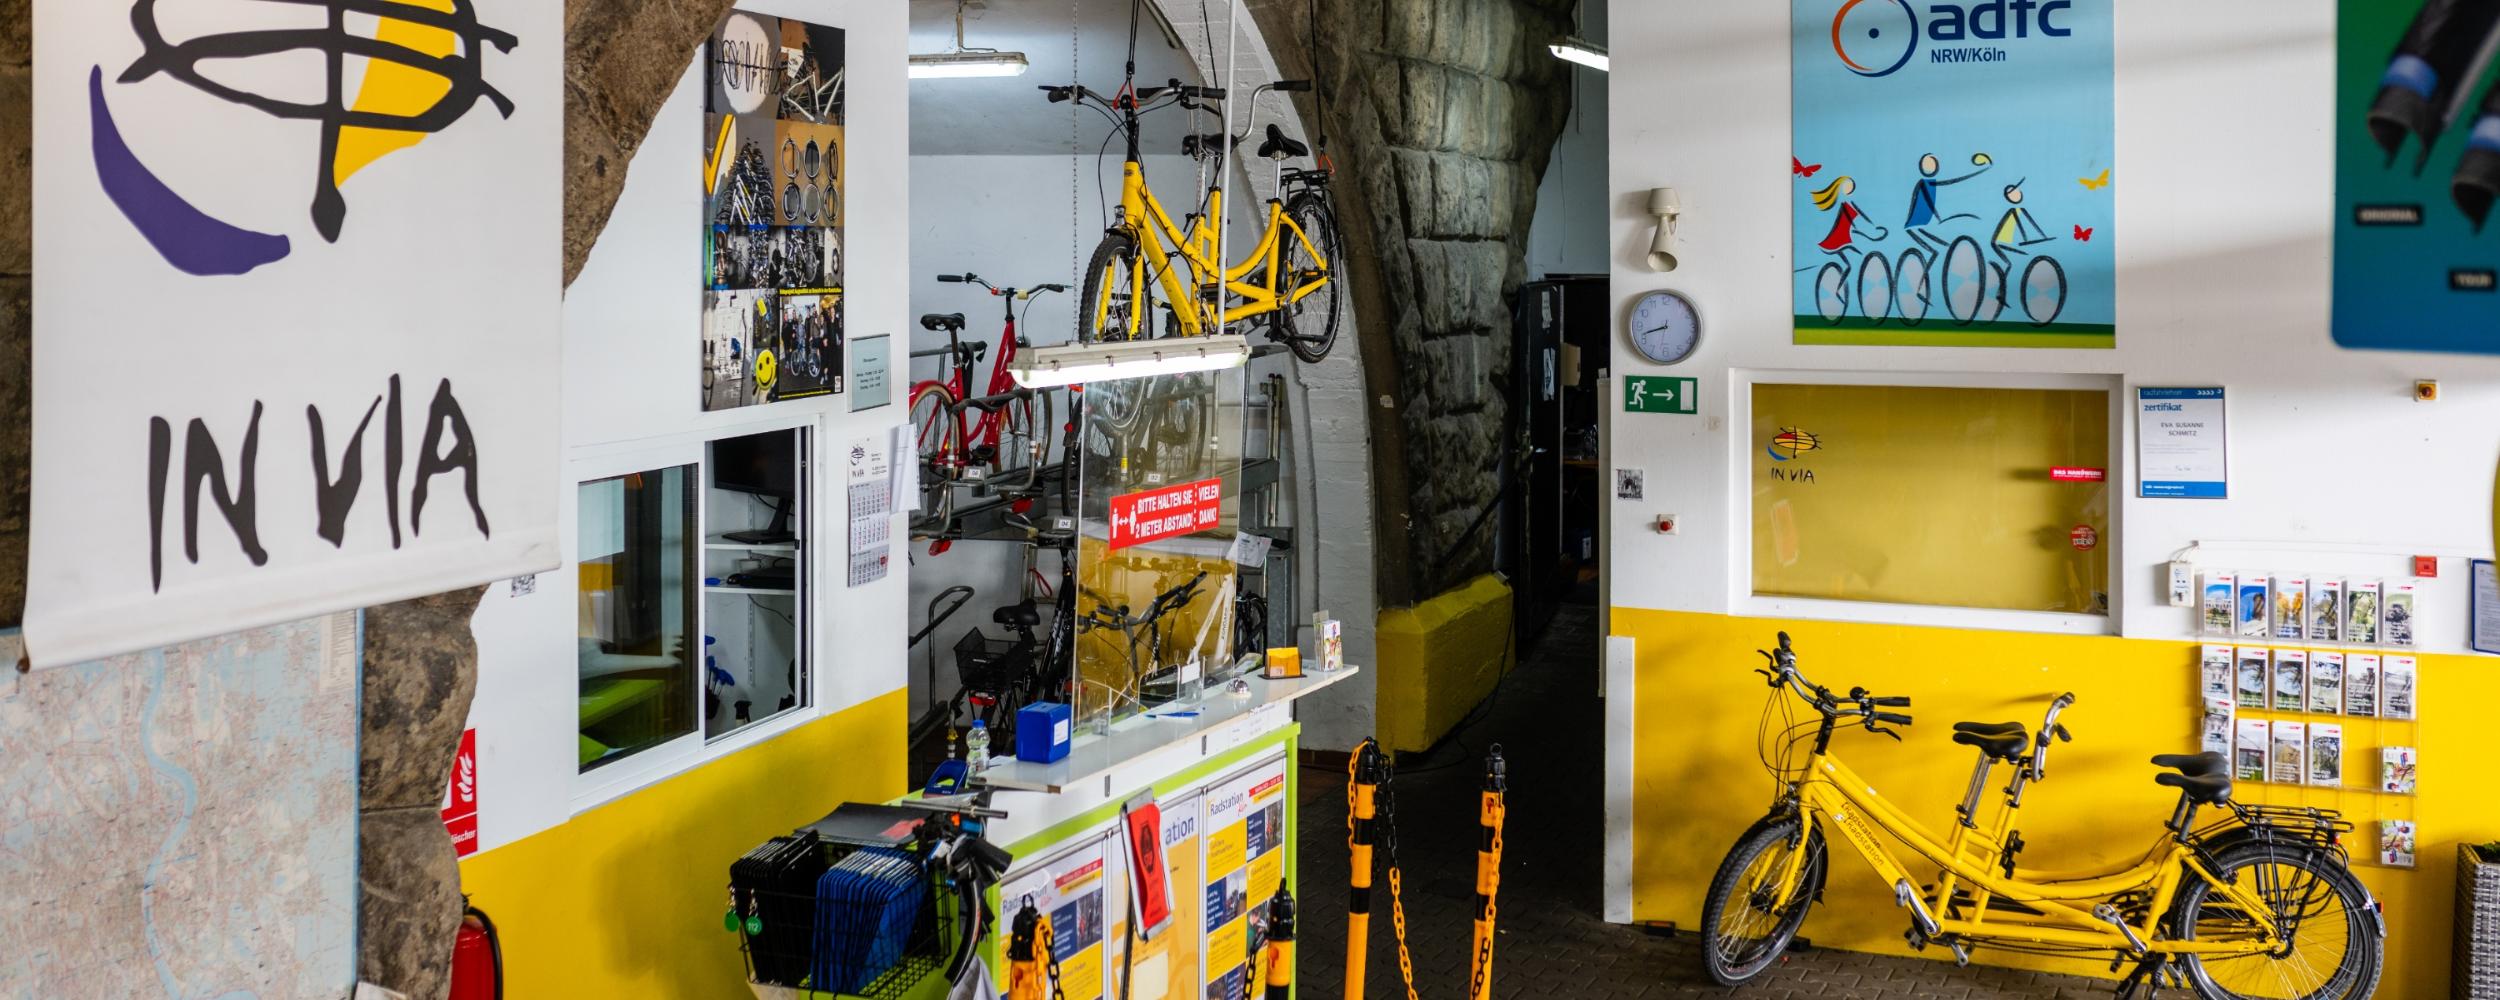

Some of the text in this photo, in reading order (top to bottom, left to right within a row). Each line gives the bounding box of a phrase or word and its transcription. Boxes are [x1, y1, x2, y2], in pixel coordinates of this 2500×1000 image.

[1931, 48, 2006, 64] NRW/Köln
[2144, 402, 2183, 412] zertifikat
[148, 373, 490, 594] IN VIA
[1771, 467, 1815, 484] IN VIA
[1137, 489, 1193, 514] BITTE HALTEN SIE
[1198, 484, 1220, 502] VIELEN
[1199, 507, 1217, 524] DANK!
[1135, 523, 1140, 538] 2
[1141, 518, 1163, 538] METER
[1210, 791, 1244, 816] Radstation
